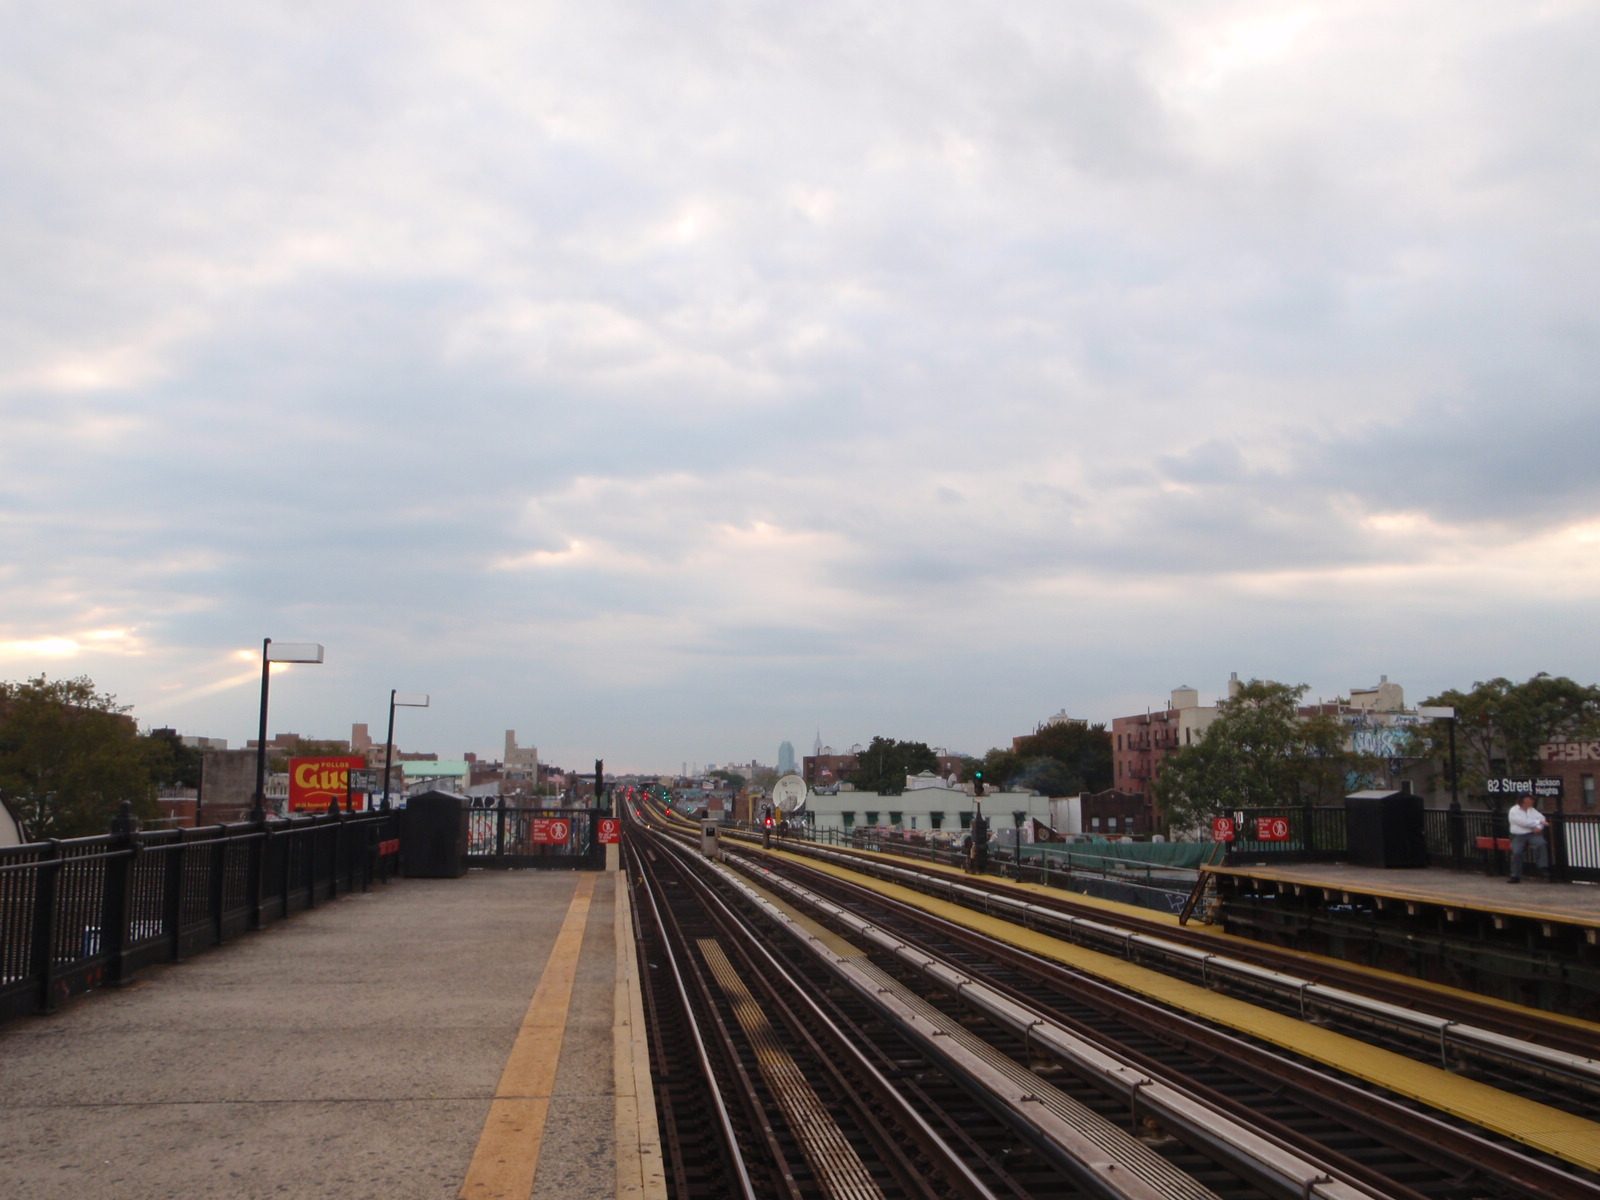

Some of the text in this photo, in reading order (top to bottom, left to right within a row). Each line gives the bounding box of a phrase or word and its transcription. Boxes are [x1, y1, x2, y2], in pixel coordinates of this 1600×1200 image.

[1487, 778, 1533, 793] 82 Street
[1535, 778, 1560, 786] Jackson
[1535, 787, 1558, 796] Heights
